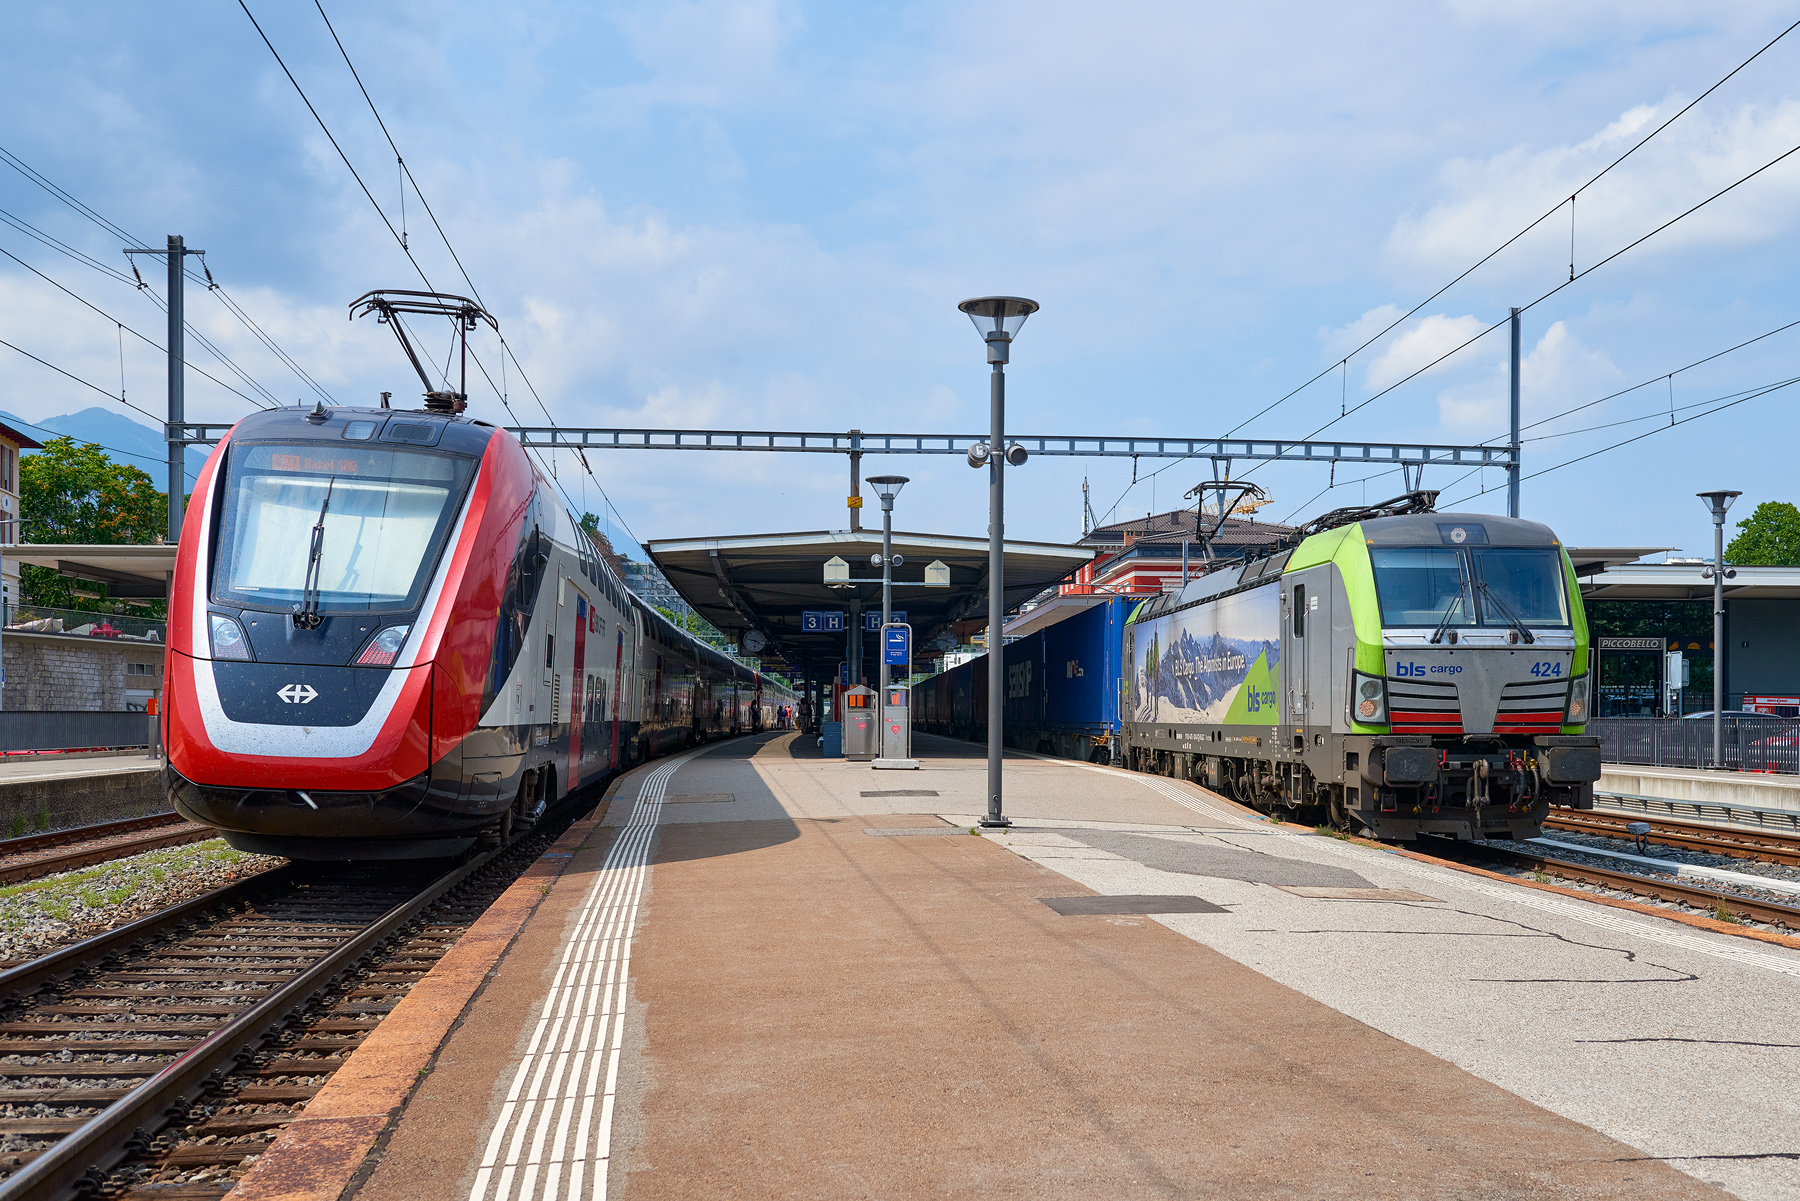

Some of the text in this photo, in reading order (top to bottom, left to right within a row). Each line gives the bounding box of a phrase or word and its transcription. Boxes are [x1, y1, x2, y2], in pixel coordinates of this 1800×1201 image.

[305, 458, 334, 470] Basel
[808, 617, 839, 628] 3 H
[871, 617, 880, 628] H
[1602, 639, 1659, 648] PICCOBELLO
[1195, 656, 1203, 674] The
[1222, 652, 1227, 671] in
[1227, 651, 1245, 674] Europe.
[1396, 661, 1463, 677] bls cargo
[1530, 661, 1562, 677] 424
[1247, 685, 1276, 712] bls cargo
